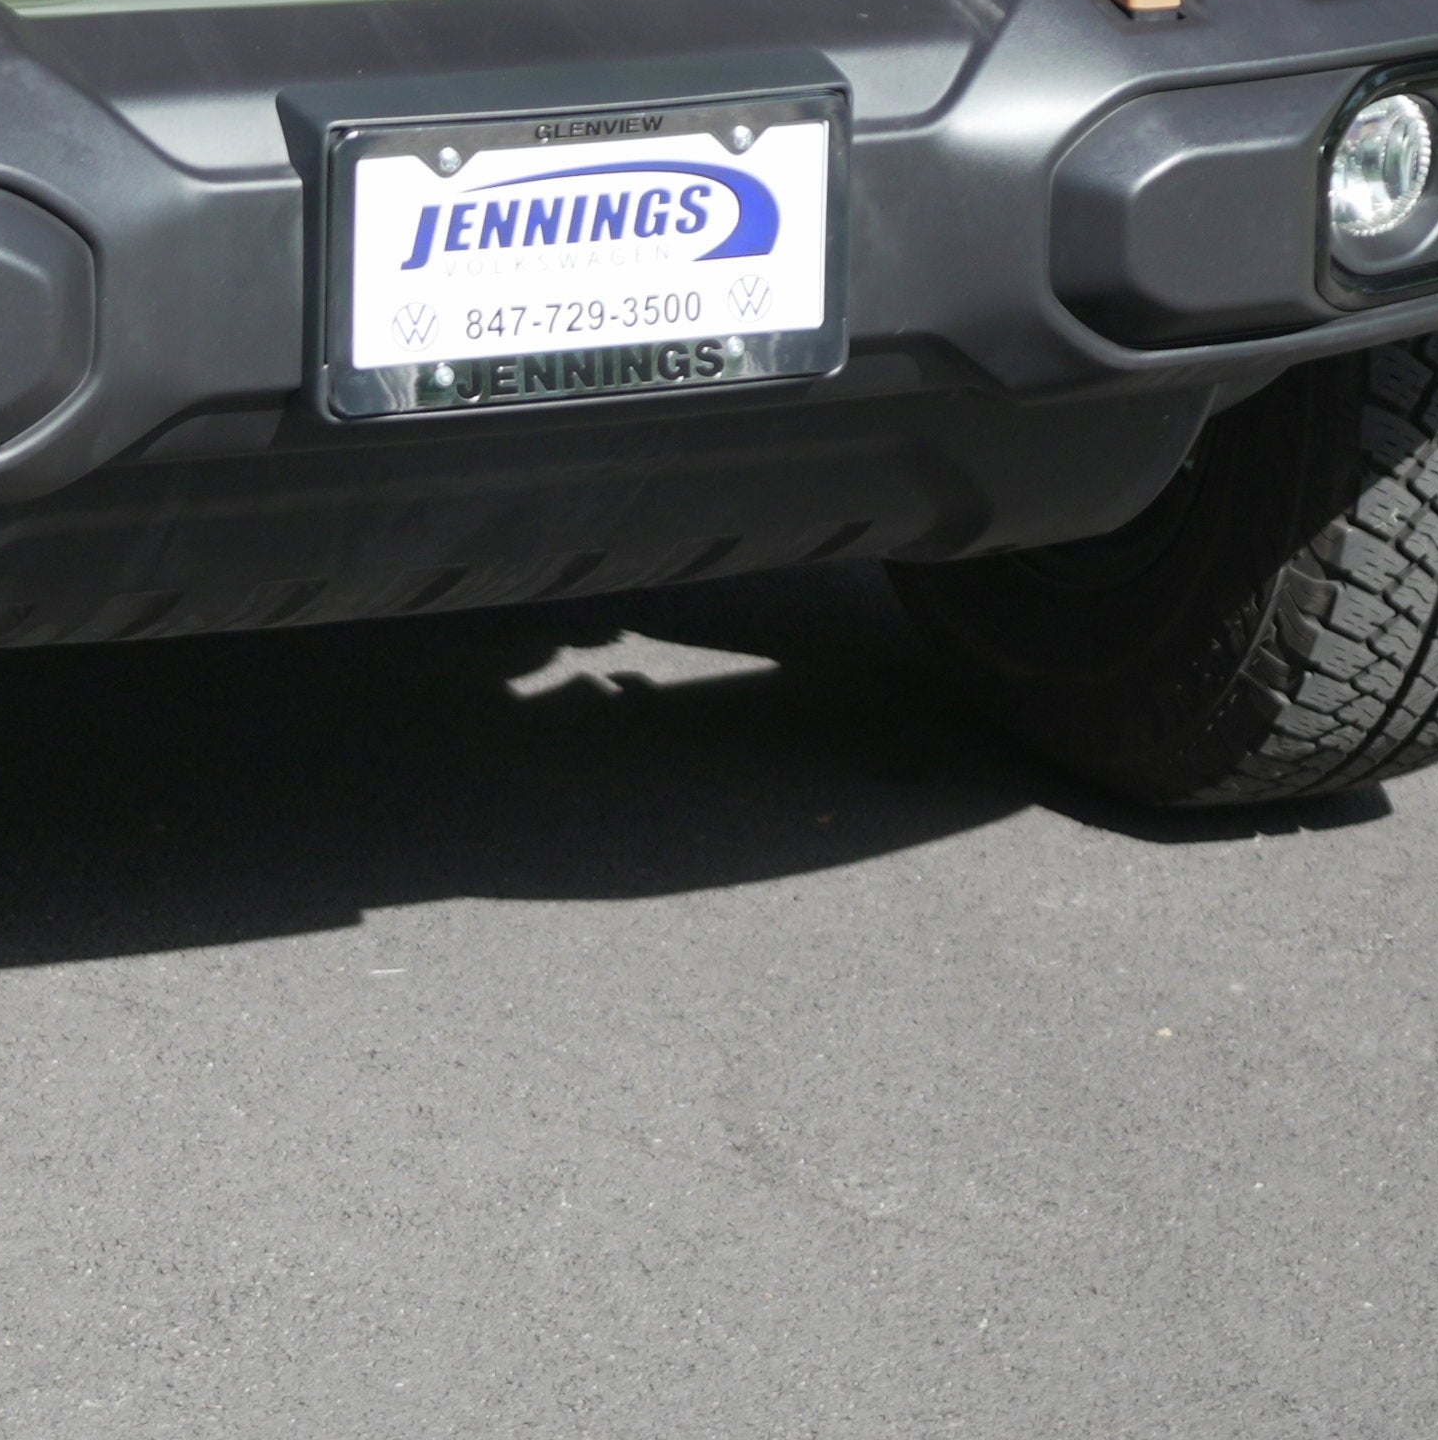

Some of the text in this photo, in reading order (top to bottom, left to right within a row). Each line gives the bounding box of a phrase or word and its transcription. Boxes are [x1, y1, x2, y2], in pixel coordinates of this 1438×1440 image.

[534, 114, 664, 142] GLENVIEW
[400, 183, 712, 271] JENNINGS
[443, 245, 671, 278] VOLKSWAGEN
[465, 290, 703, 340] 847-729-3500
[456, 338, 724, 401] JENNINGS
